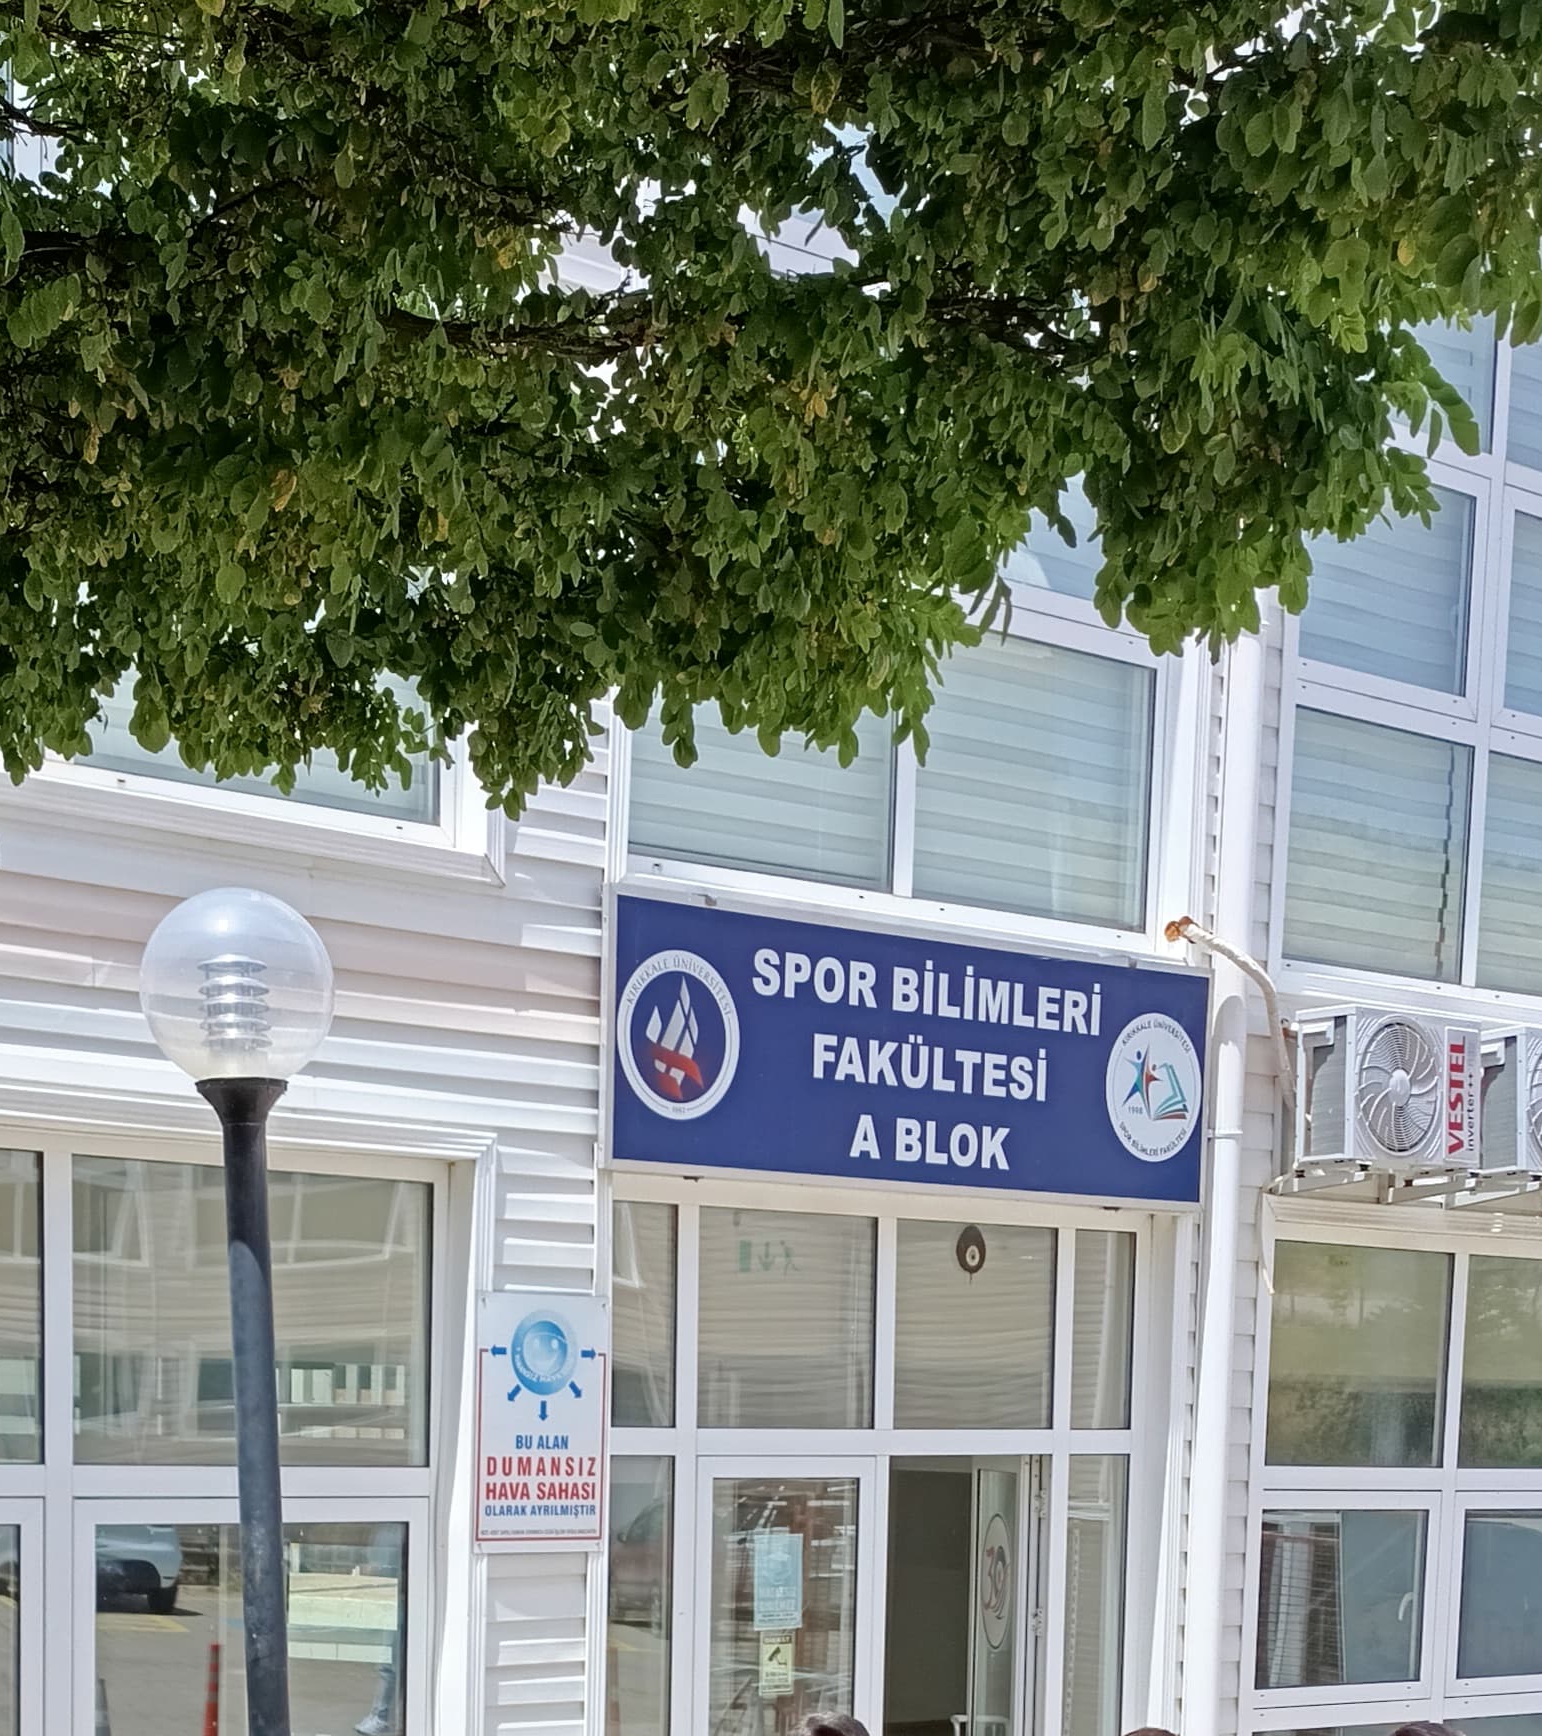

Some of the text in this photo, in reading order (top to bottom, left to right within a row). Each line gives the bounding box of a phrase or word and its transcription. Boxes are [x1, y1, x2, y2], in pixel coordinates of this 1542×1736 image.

[625, 958, 670, 1006] KIRIKKALE
[752, 948, 1102, 1036] SPOR BİLİMLERİ
[812, 1032, 1048, 1102] FAKÜLTESİ
[1448, 1036, 1465, 1155] VESTEL
[849, 1114, 1010, 1170] A BLOK
[515, 1434, 568, 1450] BU ALAN
[486, 1456, 596, 1477] DUMANSIZ
[484, 1504, 596, 1519] OLARAK AYRILMIŞTIR
[485, 1482, 596, 1500] HAVA SAHASI
